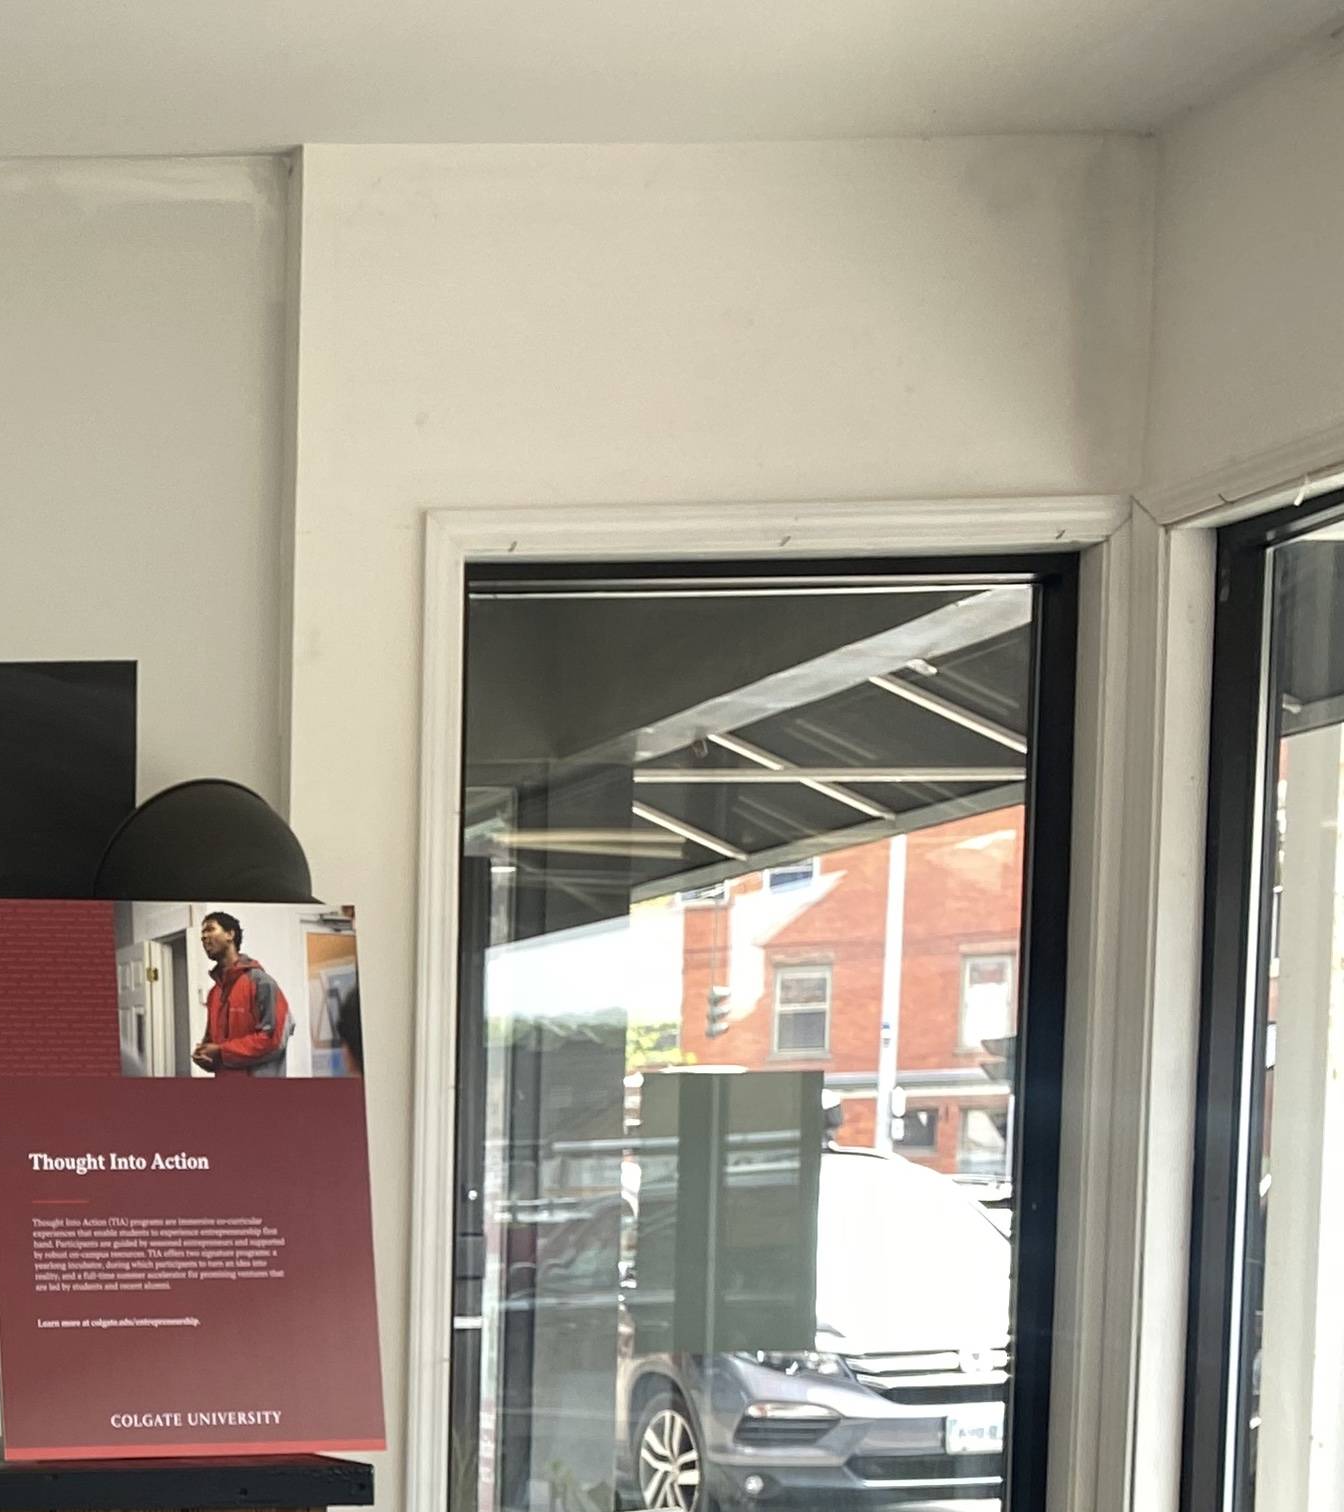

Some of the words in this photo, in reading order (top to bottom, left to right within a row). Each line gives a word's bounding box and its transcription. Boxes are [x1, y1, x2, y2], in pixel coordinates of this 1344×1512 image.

[28, 1152, 105, 1175] Thought
[110, 1153, 146, 1170] Into
[151, 1152, 209, 1170] Action
[110, 1413, 182, 1428] COLGATE
[187, 1411, 282, 1426] UNIVERSITY
